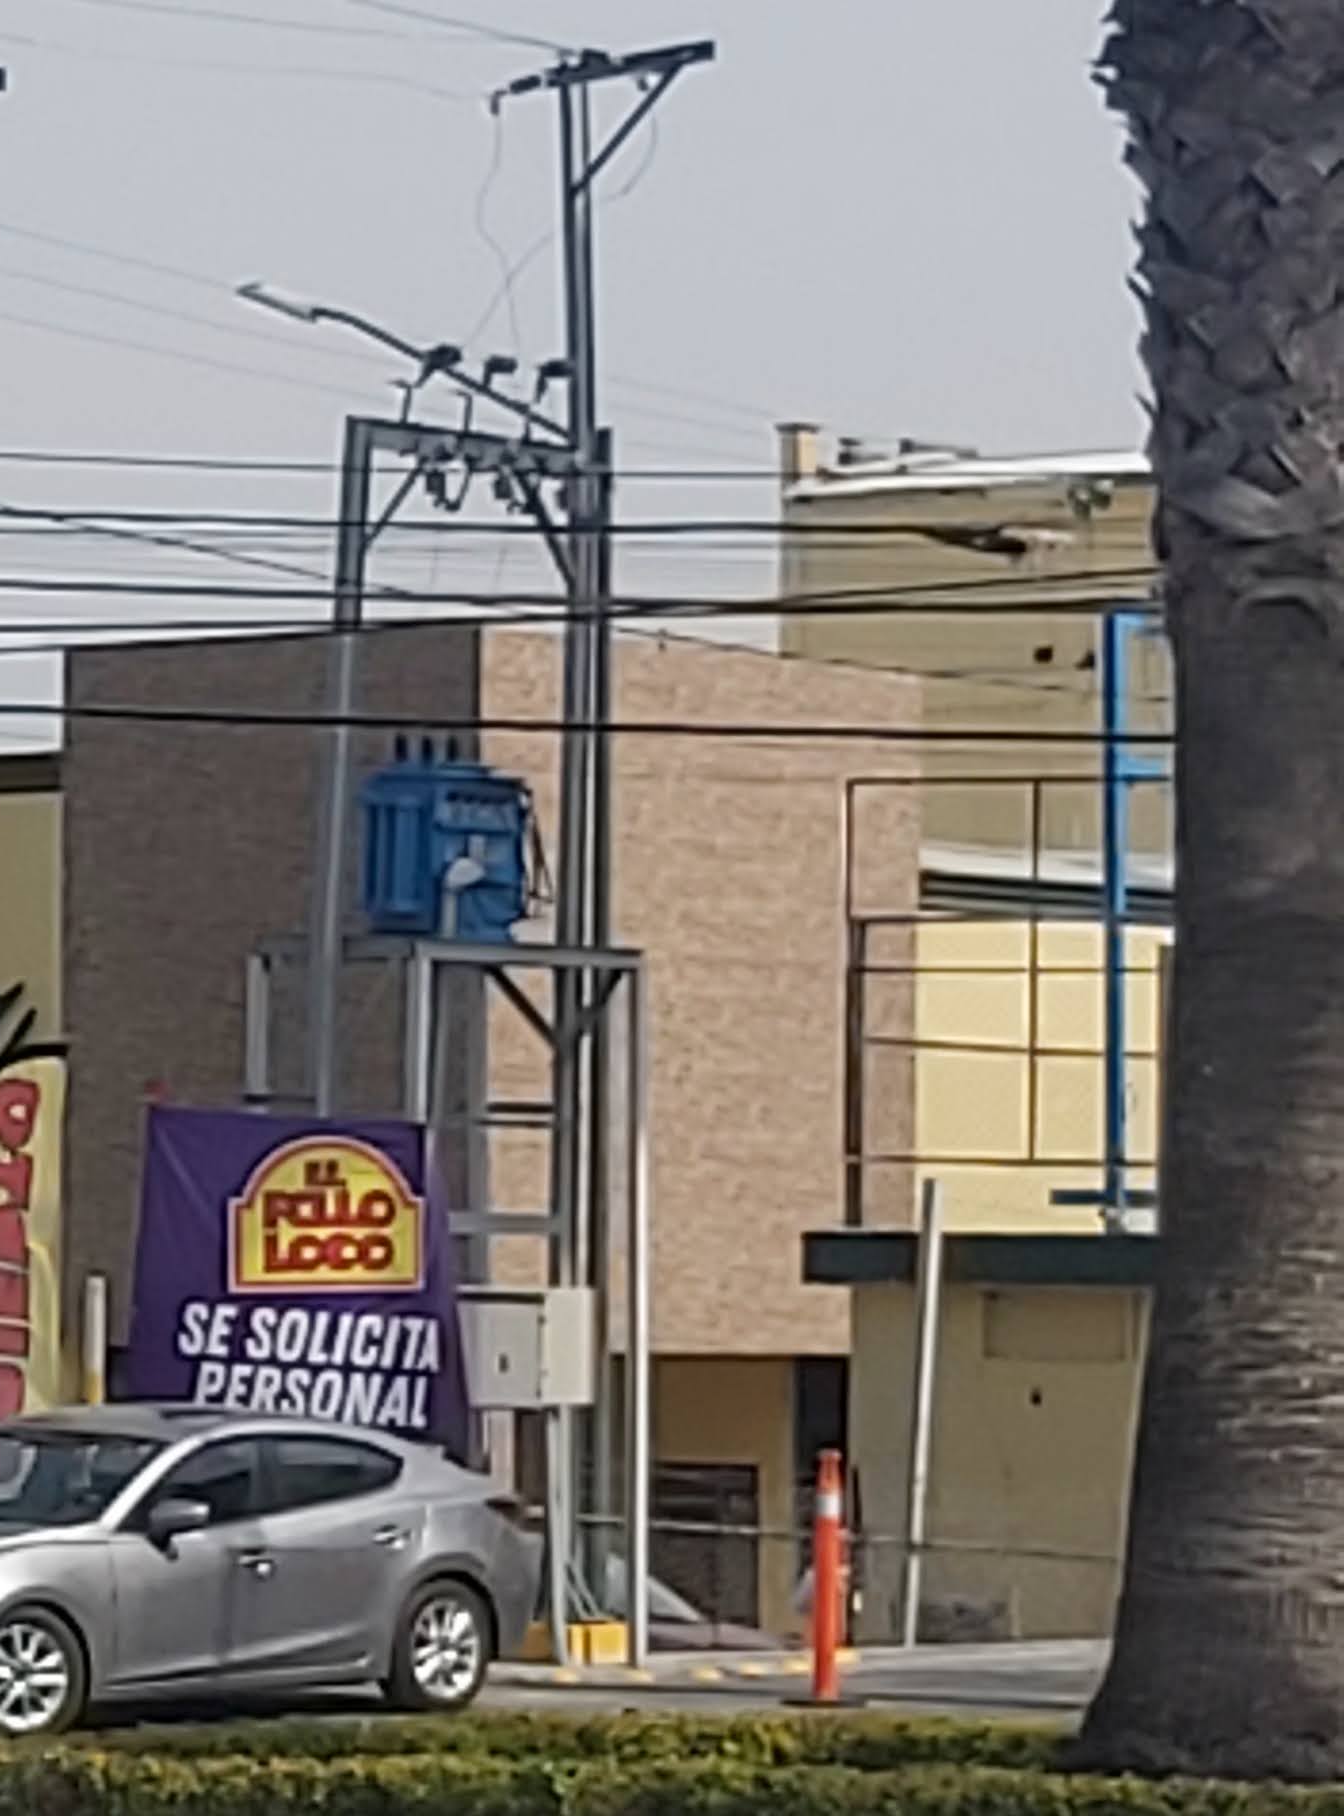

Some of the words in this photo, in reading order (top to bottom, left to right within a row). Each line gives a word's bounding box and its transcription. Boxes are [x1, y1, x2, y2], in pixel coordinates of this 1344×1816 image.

[264, 1188, 396, 1229] POLLO
[264, 1232, 395, 1273] LOCO
[178, 1302, 238, 1356] SE
[244, 1306, 439, 1373] SOLICITA
[194, 1360, 428, 1428] PERSONAL
